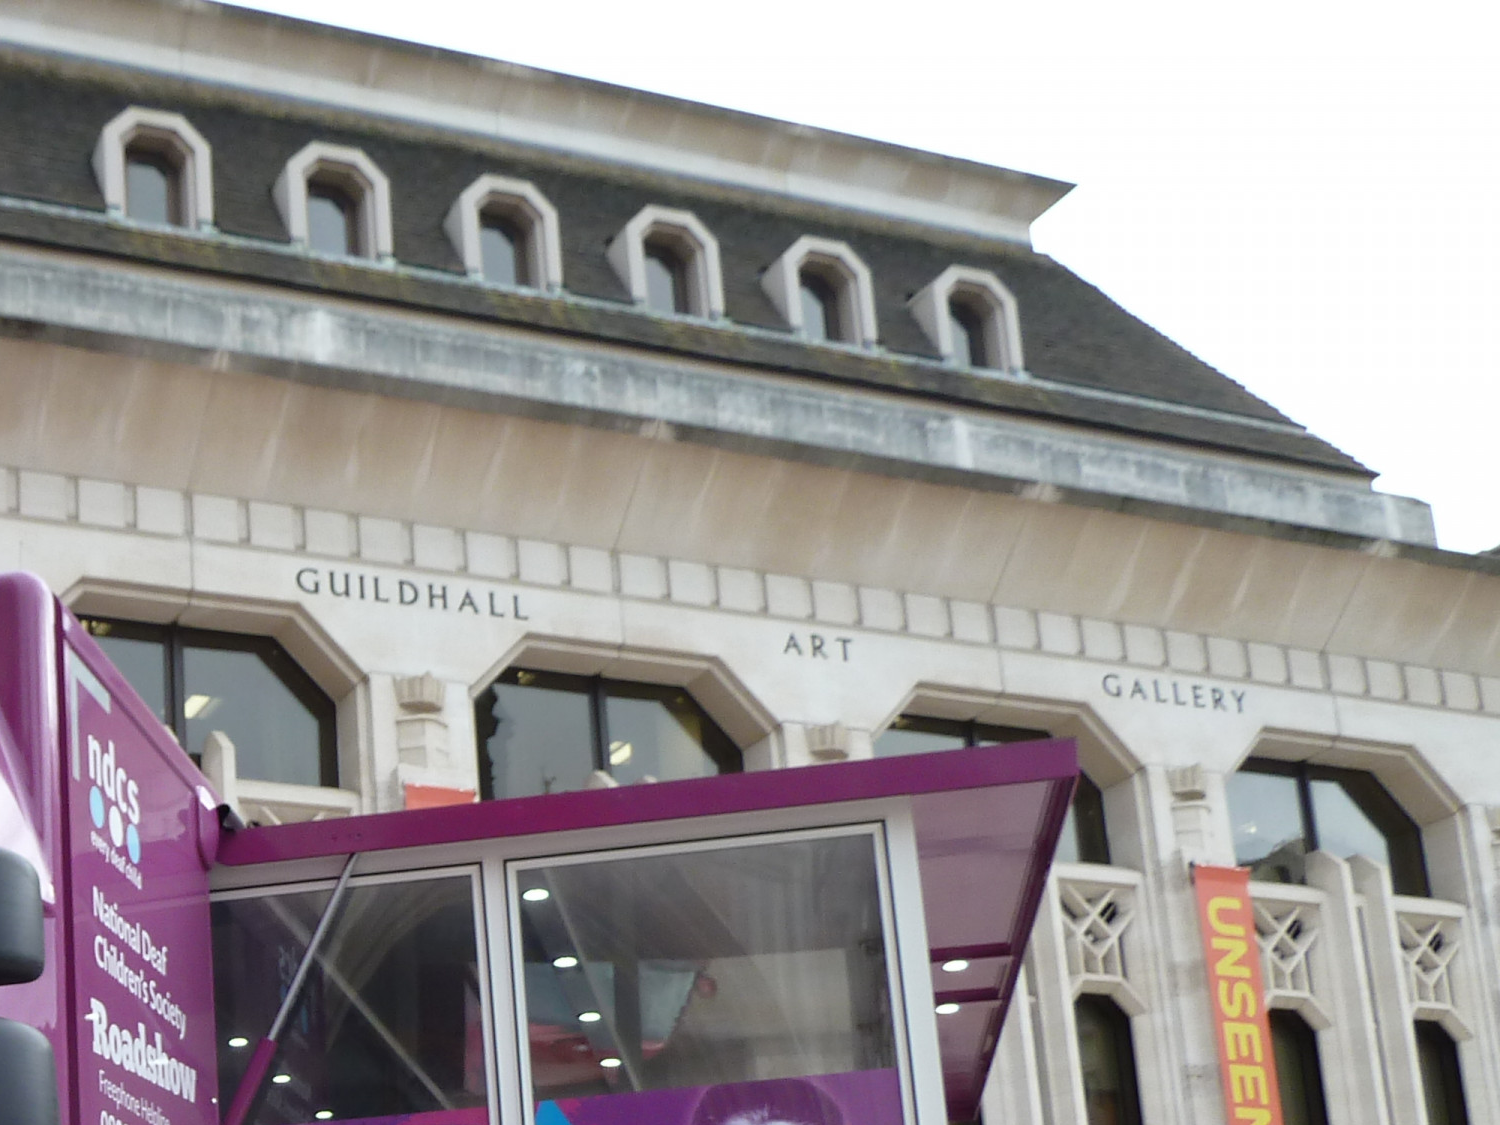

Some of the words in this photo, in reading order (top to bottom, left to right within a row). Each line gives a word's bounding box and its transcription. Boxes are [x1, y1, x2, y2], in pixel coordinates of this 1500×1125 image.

[295, 566, 530, 621] GUILDHALL
[783, 632, 854, 663] ART
[1101, 673, 1247, 715] GALLERY
[88, 733, 140, 825] ndcs
[90, 830, 110, 863] every
[110, 847, 126, 874] deaf
[126, 862, 142, 890] child
[92, 885, 141, 955] National
[141, 929, 168, 976] Deaf
[84, 996, 197, 1104] Roadshow
[149, 980, 187, 1041] Society
[99, 1069, 140, 1117] Freephone
